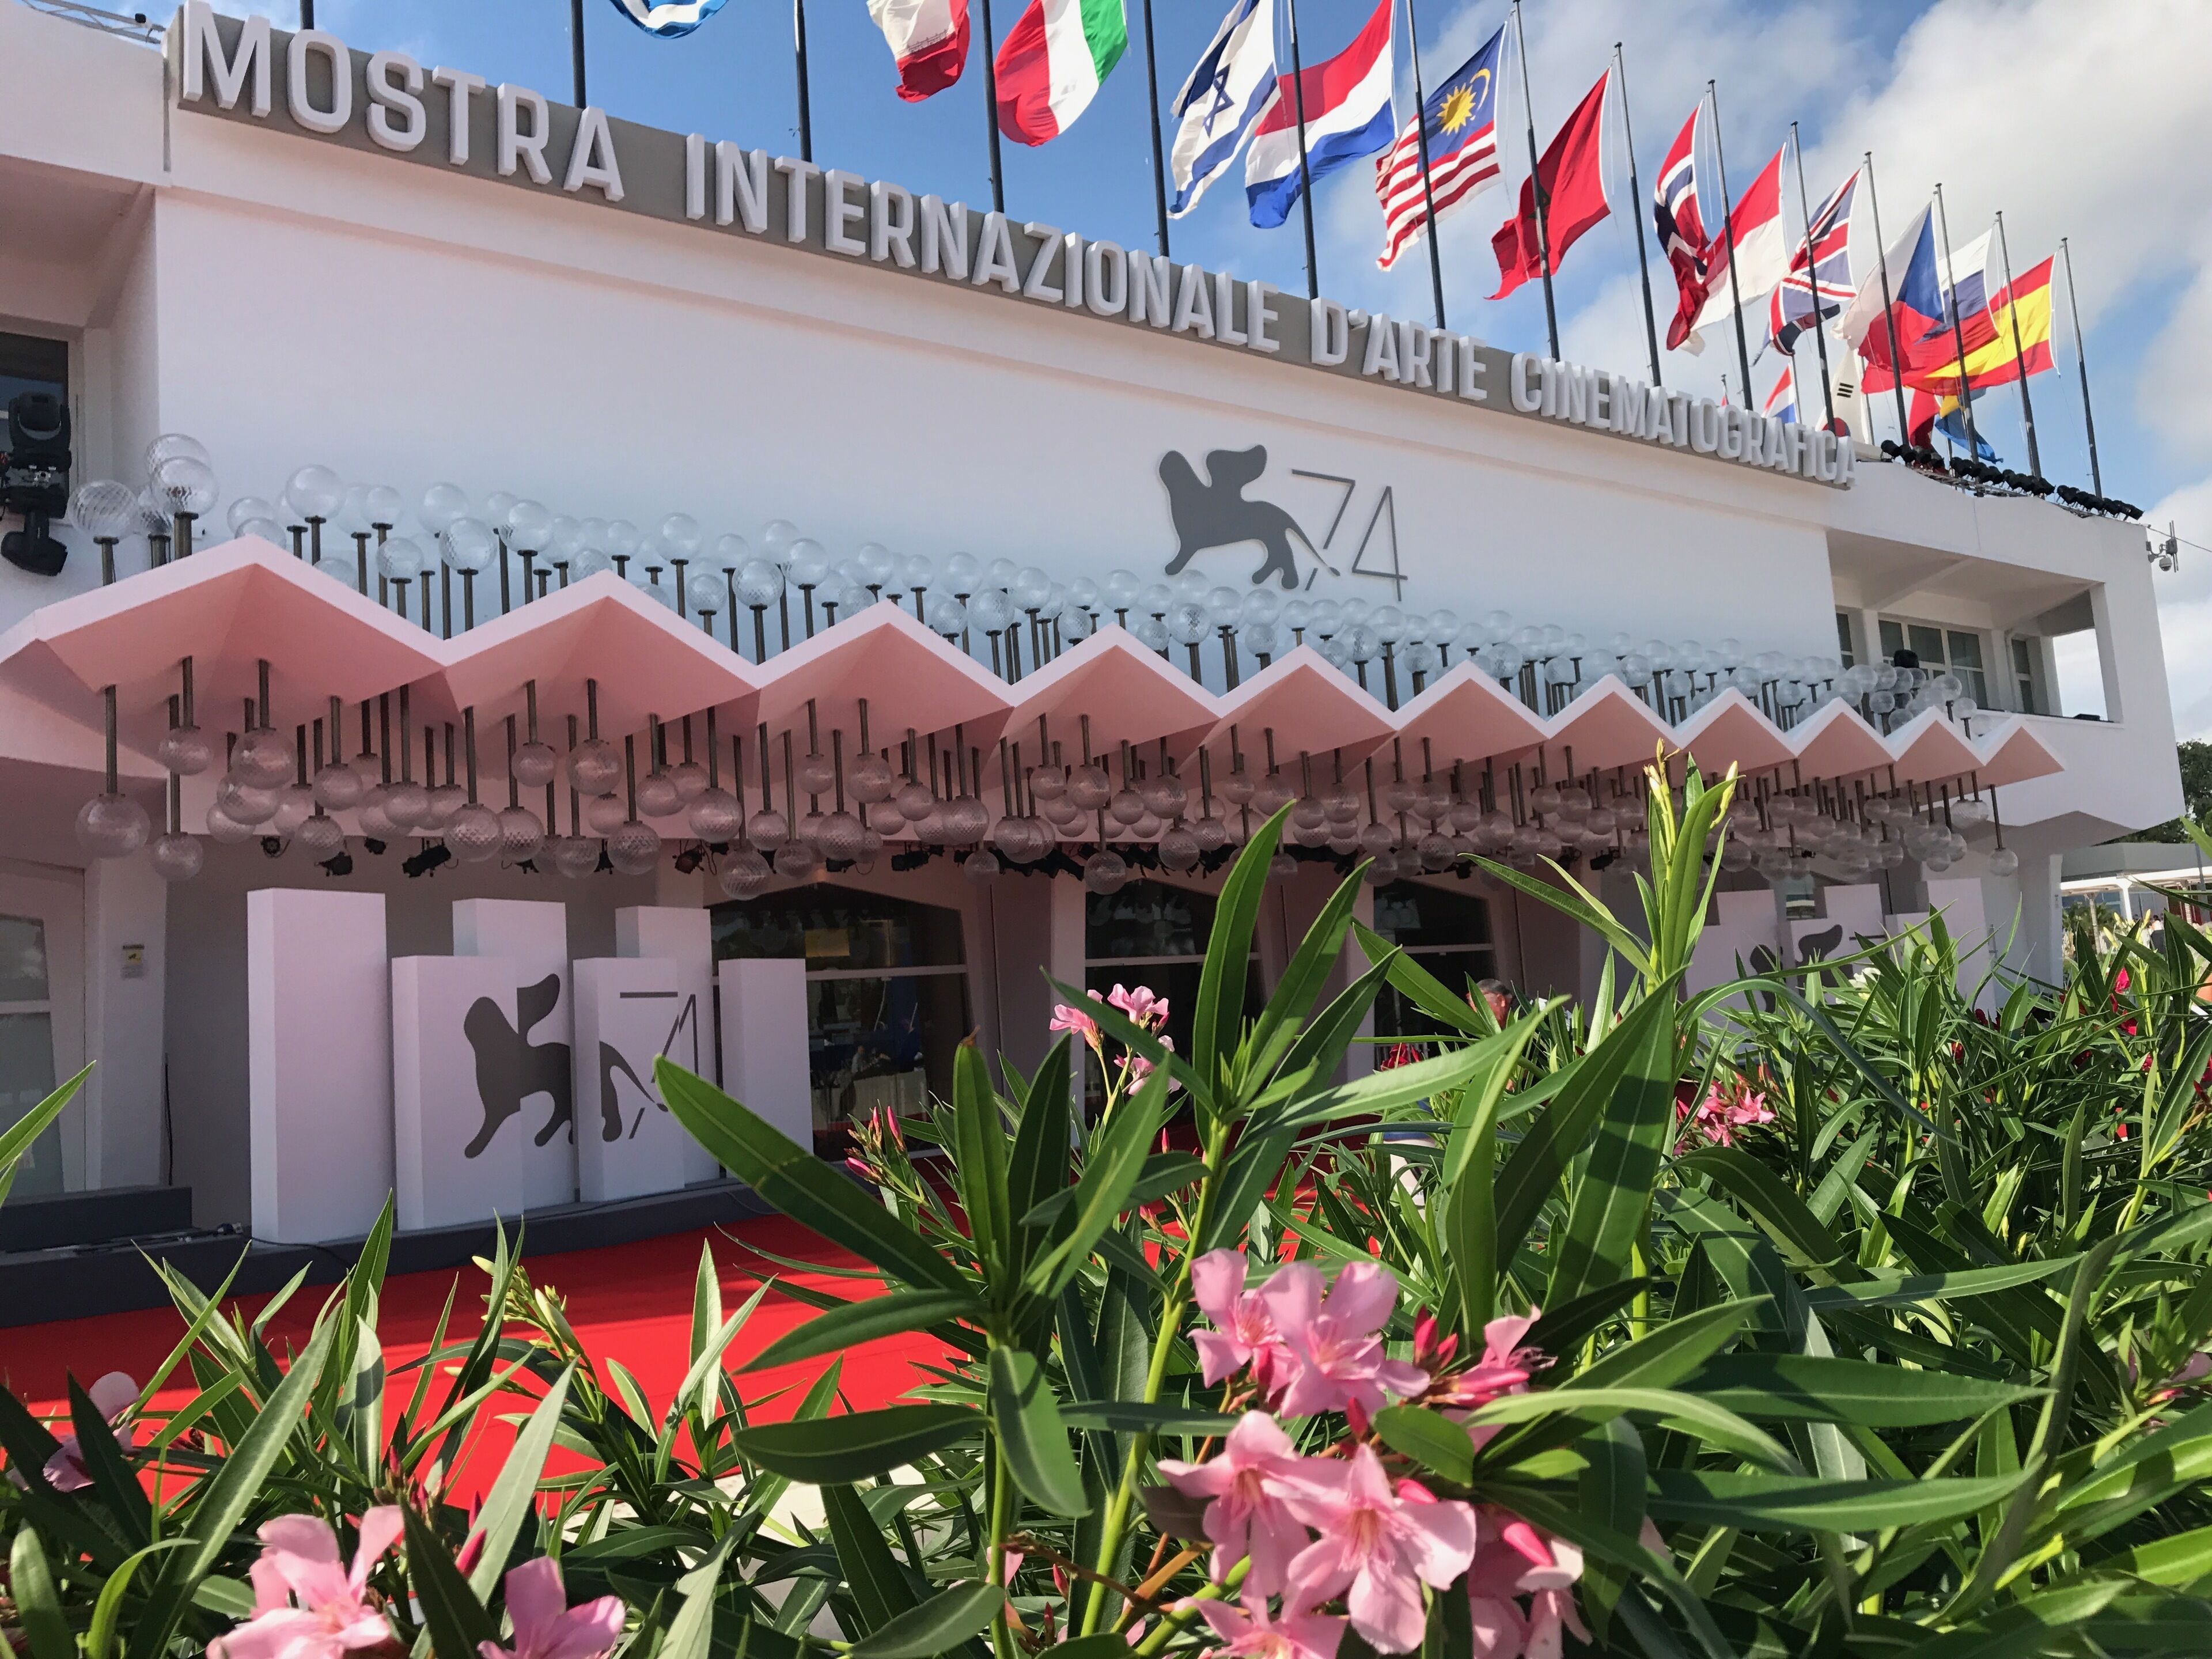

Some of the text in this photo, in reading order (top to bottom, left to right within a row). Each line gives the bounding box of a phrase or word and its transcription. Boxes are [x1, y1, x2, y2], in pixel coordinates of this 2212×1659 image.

[183, 0, 1857, 487] MOSTRA INTERNAZIONALE D'ARTE CINEMATOGRAFICA
[1291, 468, 1408, 602] 74
